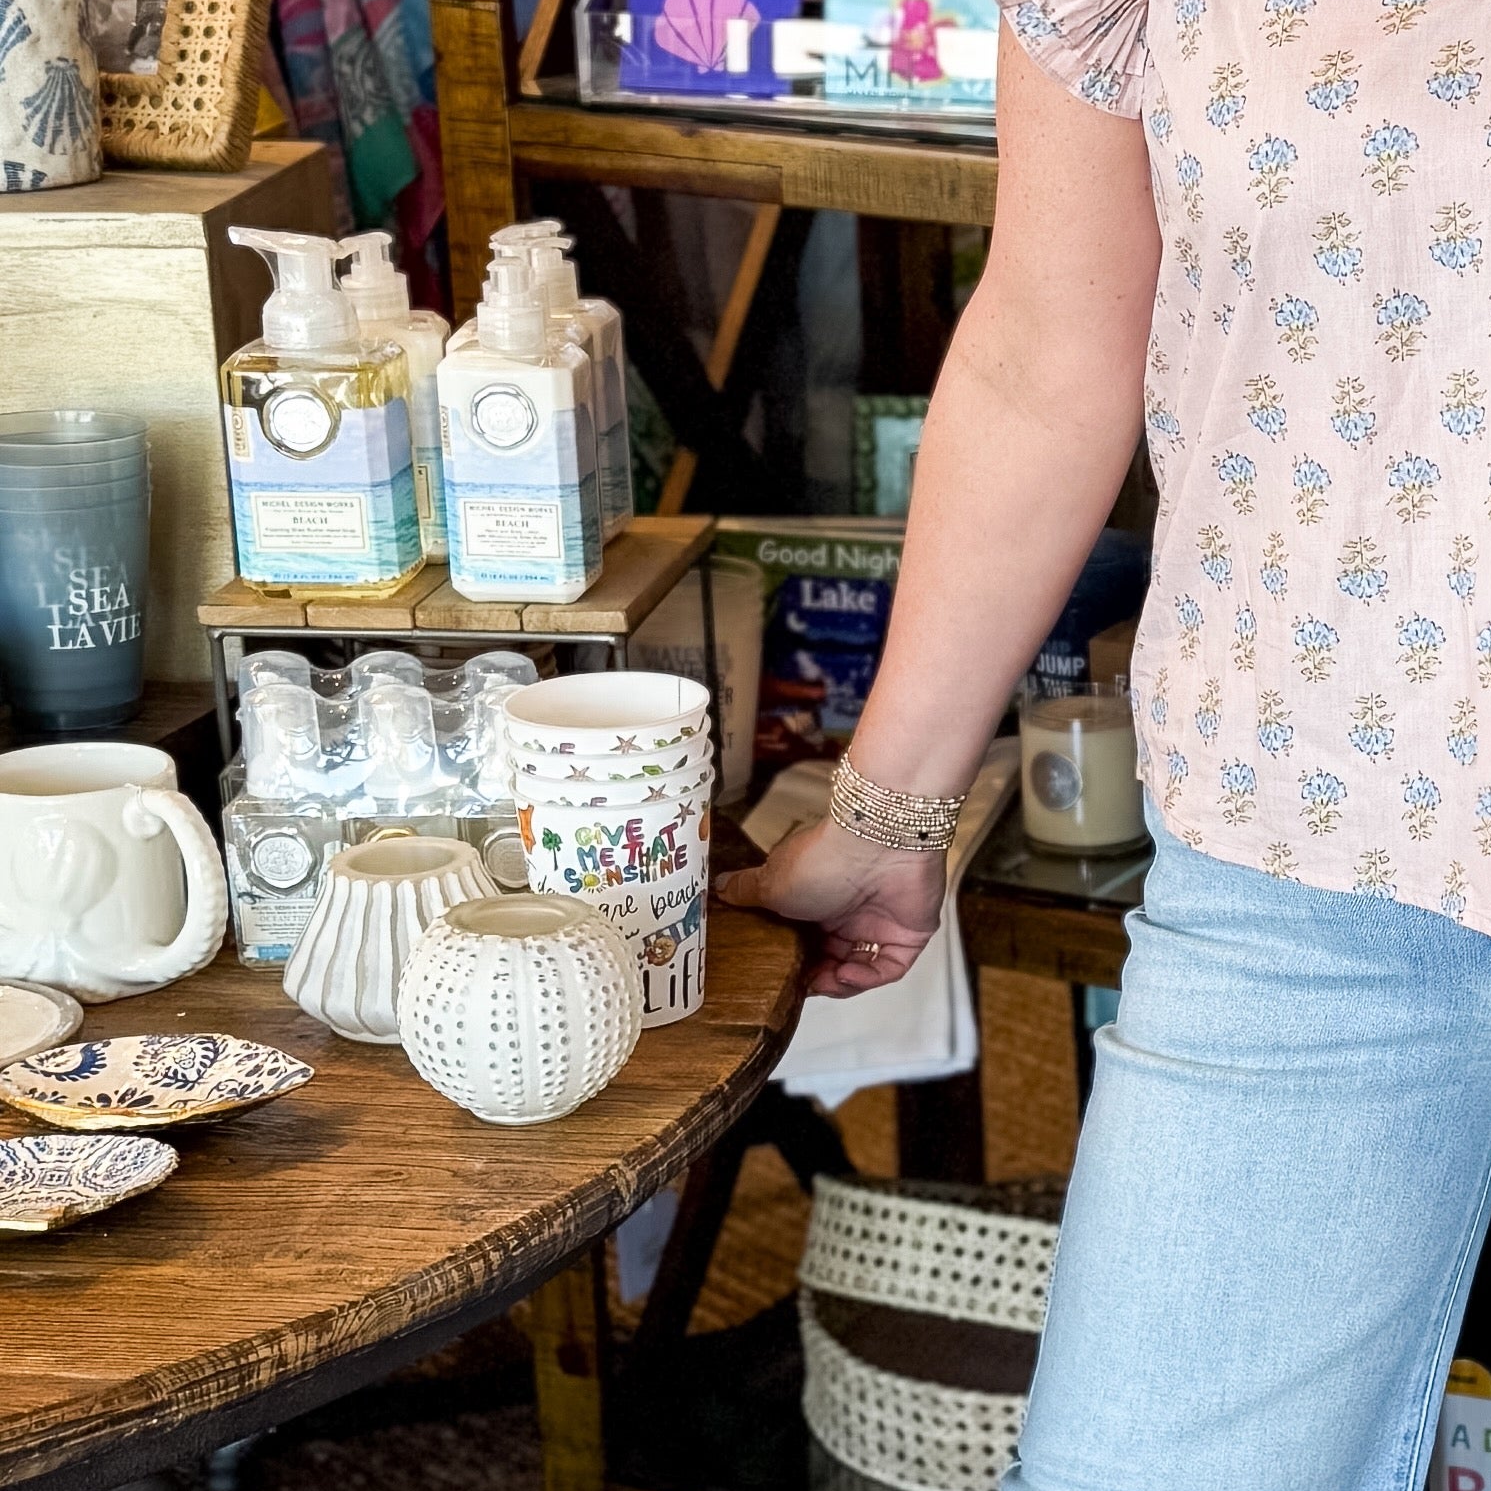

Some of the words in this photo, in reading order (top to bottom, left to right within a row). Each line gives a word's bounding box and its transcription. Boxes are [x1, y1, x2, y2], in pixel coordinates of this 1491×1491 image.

[292, 516, 328, 525] BEACH
[495, 519, 529, 528] BEACH
[758, 539, 828, 566] Good
[836, 543, 900, 578] Nigh
[69, 583, 130, 615] SEA
[801, 580, 878, 613] Lake
[47, 623, 96, 650] LA
[99, 612, 142, 646] VIE
[1037, 653, 1085, 677] JUMP
[577, 844, 616, 872] ME
[621, 822, 679, 868] THAT
[1451, 1424, 1471, 1450] A
